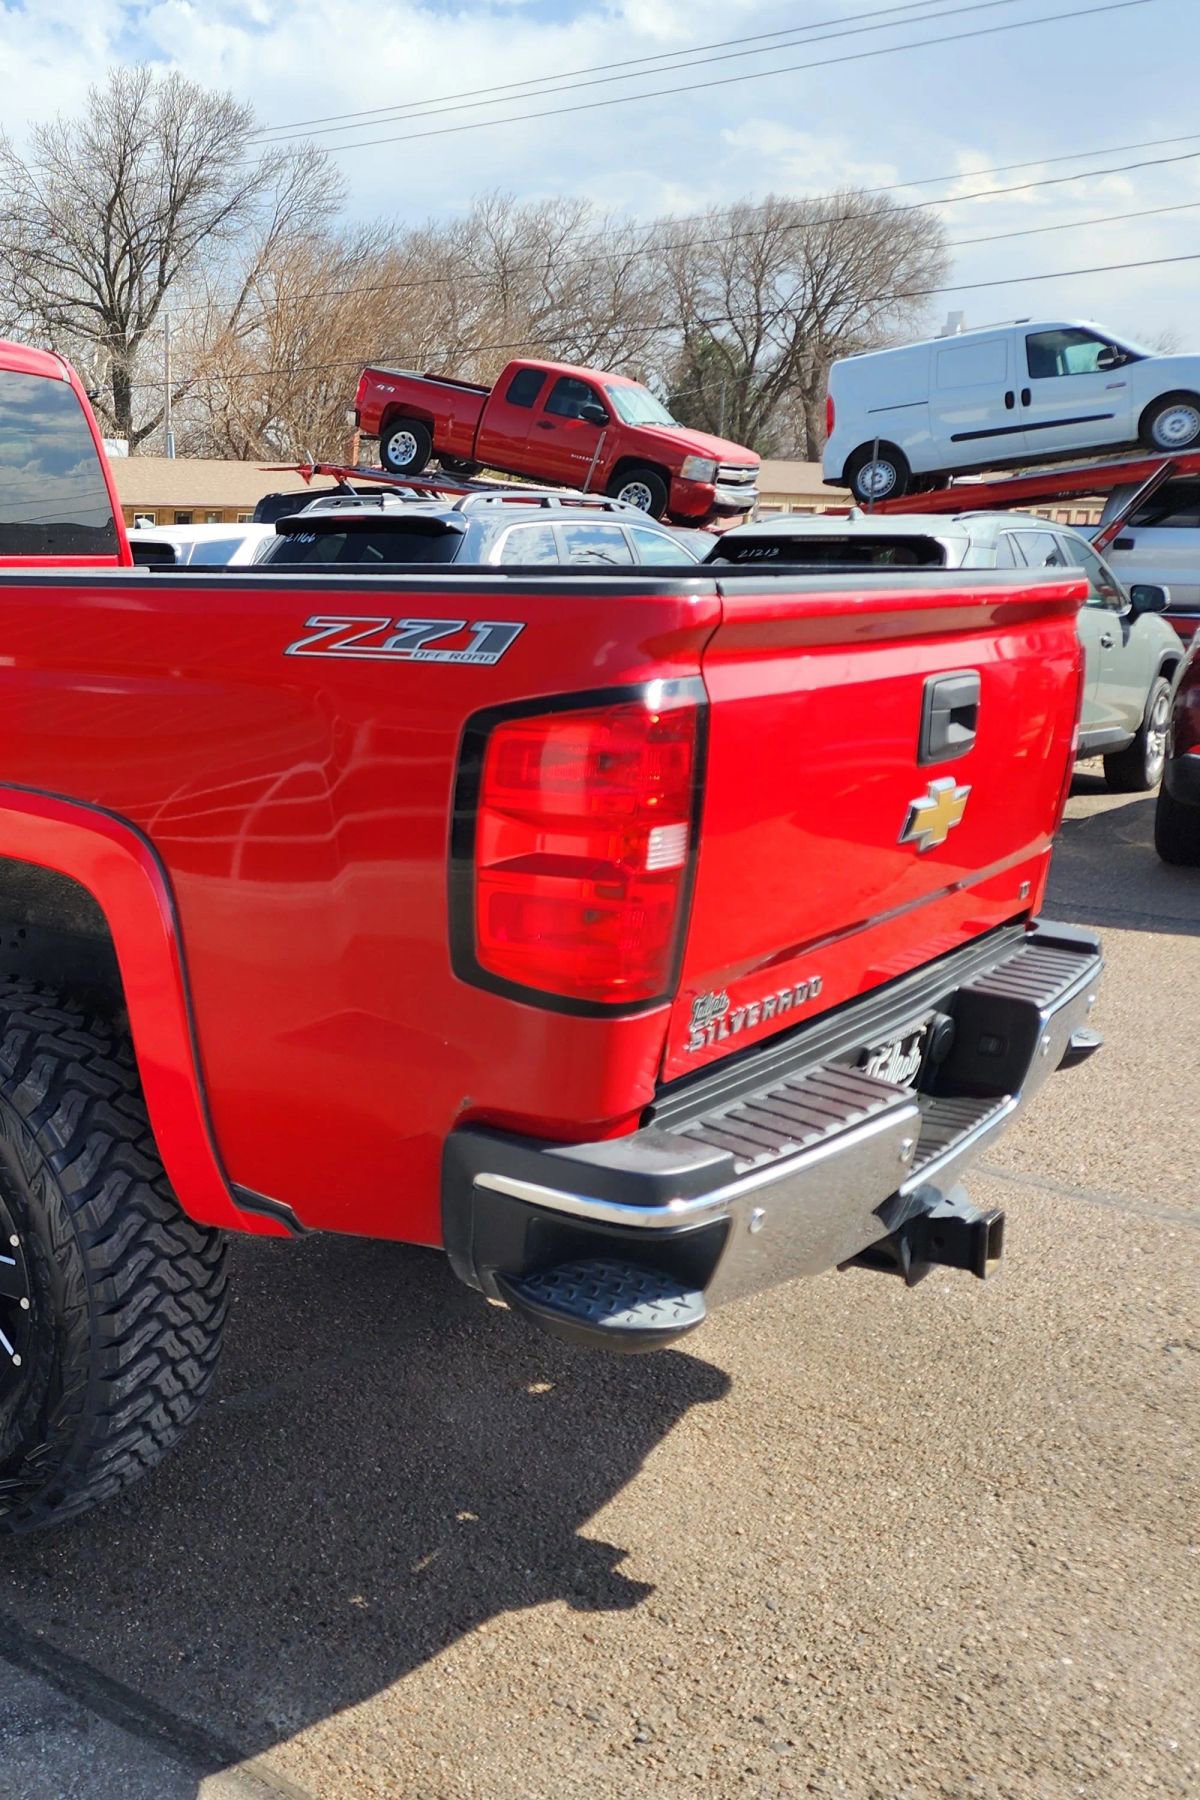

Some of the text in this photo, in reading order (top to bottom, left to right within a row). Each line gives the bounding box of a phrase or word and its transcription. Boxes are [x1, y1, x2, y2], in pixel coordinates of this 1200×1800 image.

[284, 615, 528, 665] Z71
[413, 650, 498, 662] OFF ROAD
[682, 975, 823, 1054] SILVERADO
